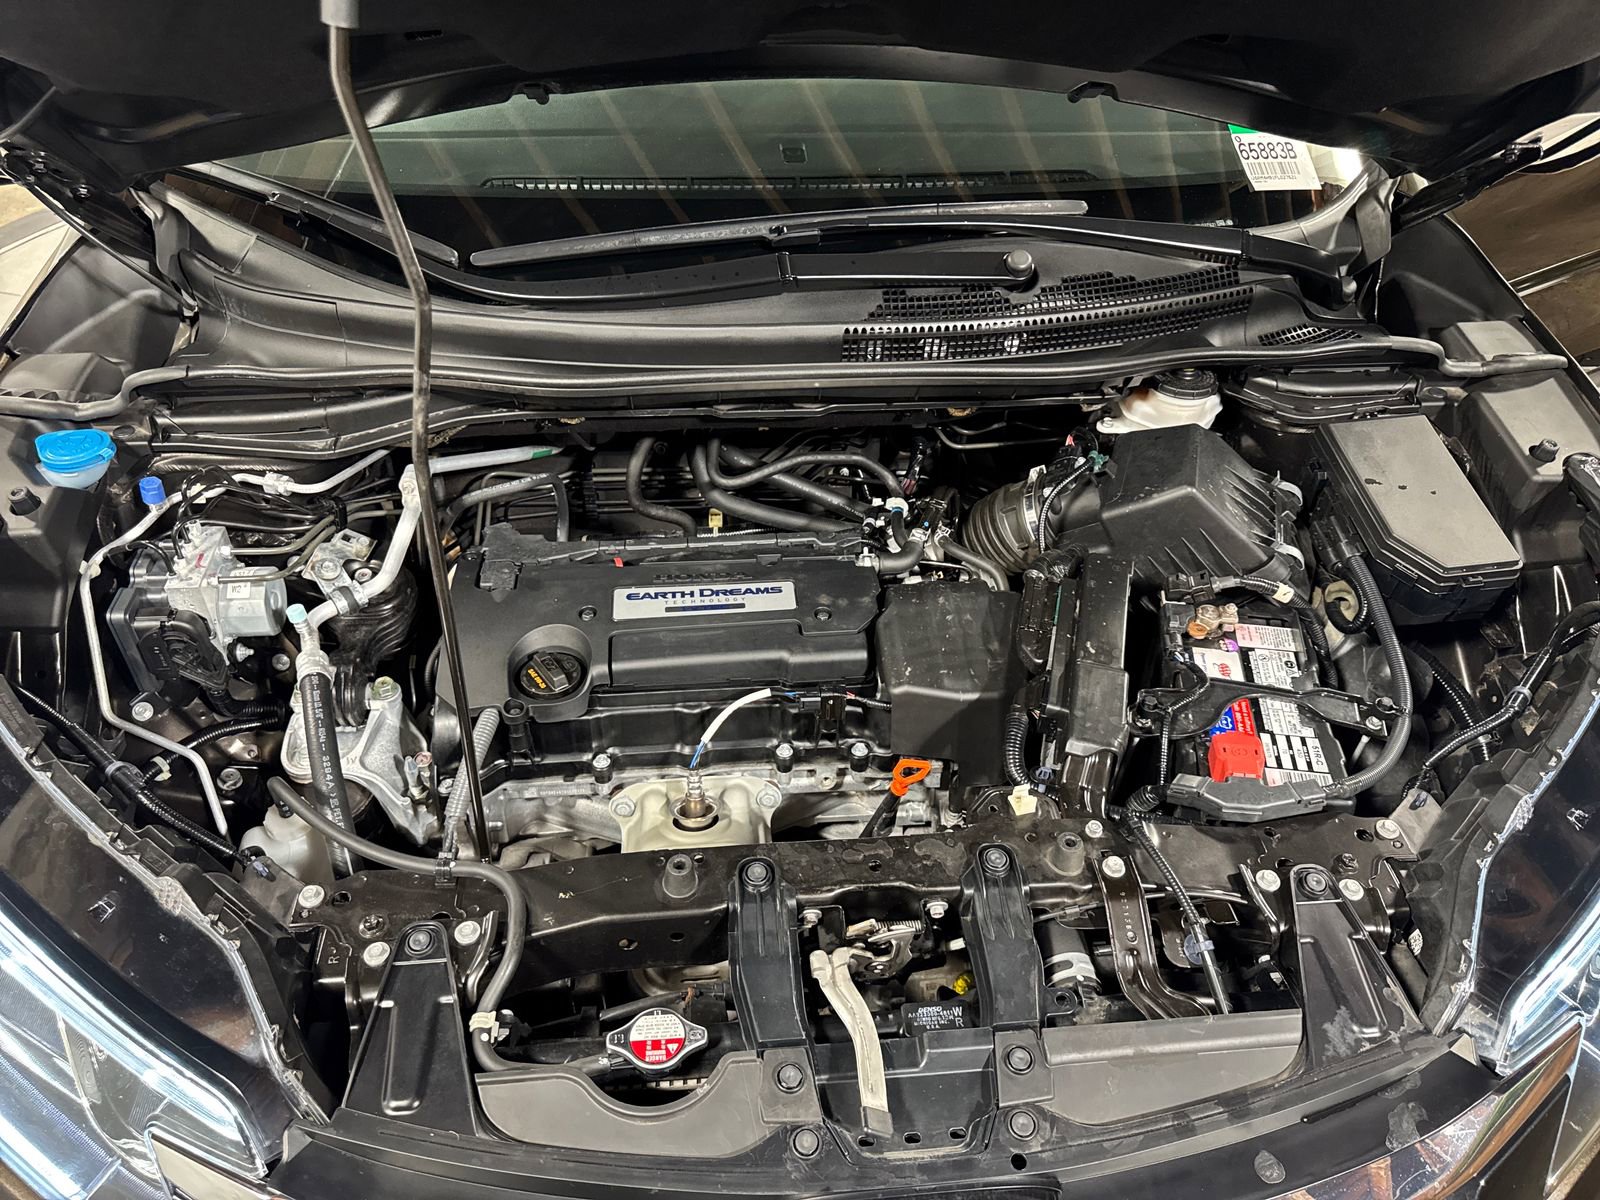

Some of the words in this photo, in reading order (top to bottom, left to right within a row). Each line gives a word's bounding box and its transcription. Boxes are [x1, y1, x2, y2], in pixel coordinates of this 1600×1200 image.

[1238, 142, 1297, 160] 65883B
[653, 571, 753, 583] HONDA
[626, 591, 695, 600] EARTH
[699, 586, 783, 598] DREAMS
[1312, 745, 1323, 766] 51R-C
[952, 1006, 962, 1016] W
[955, 1018, 964, 1027] R
